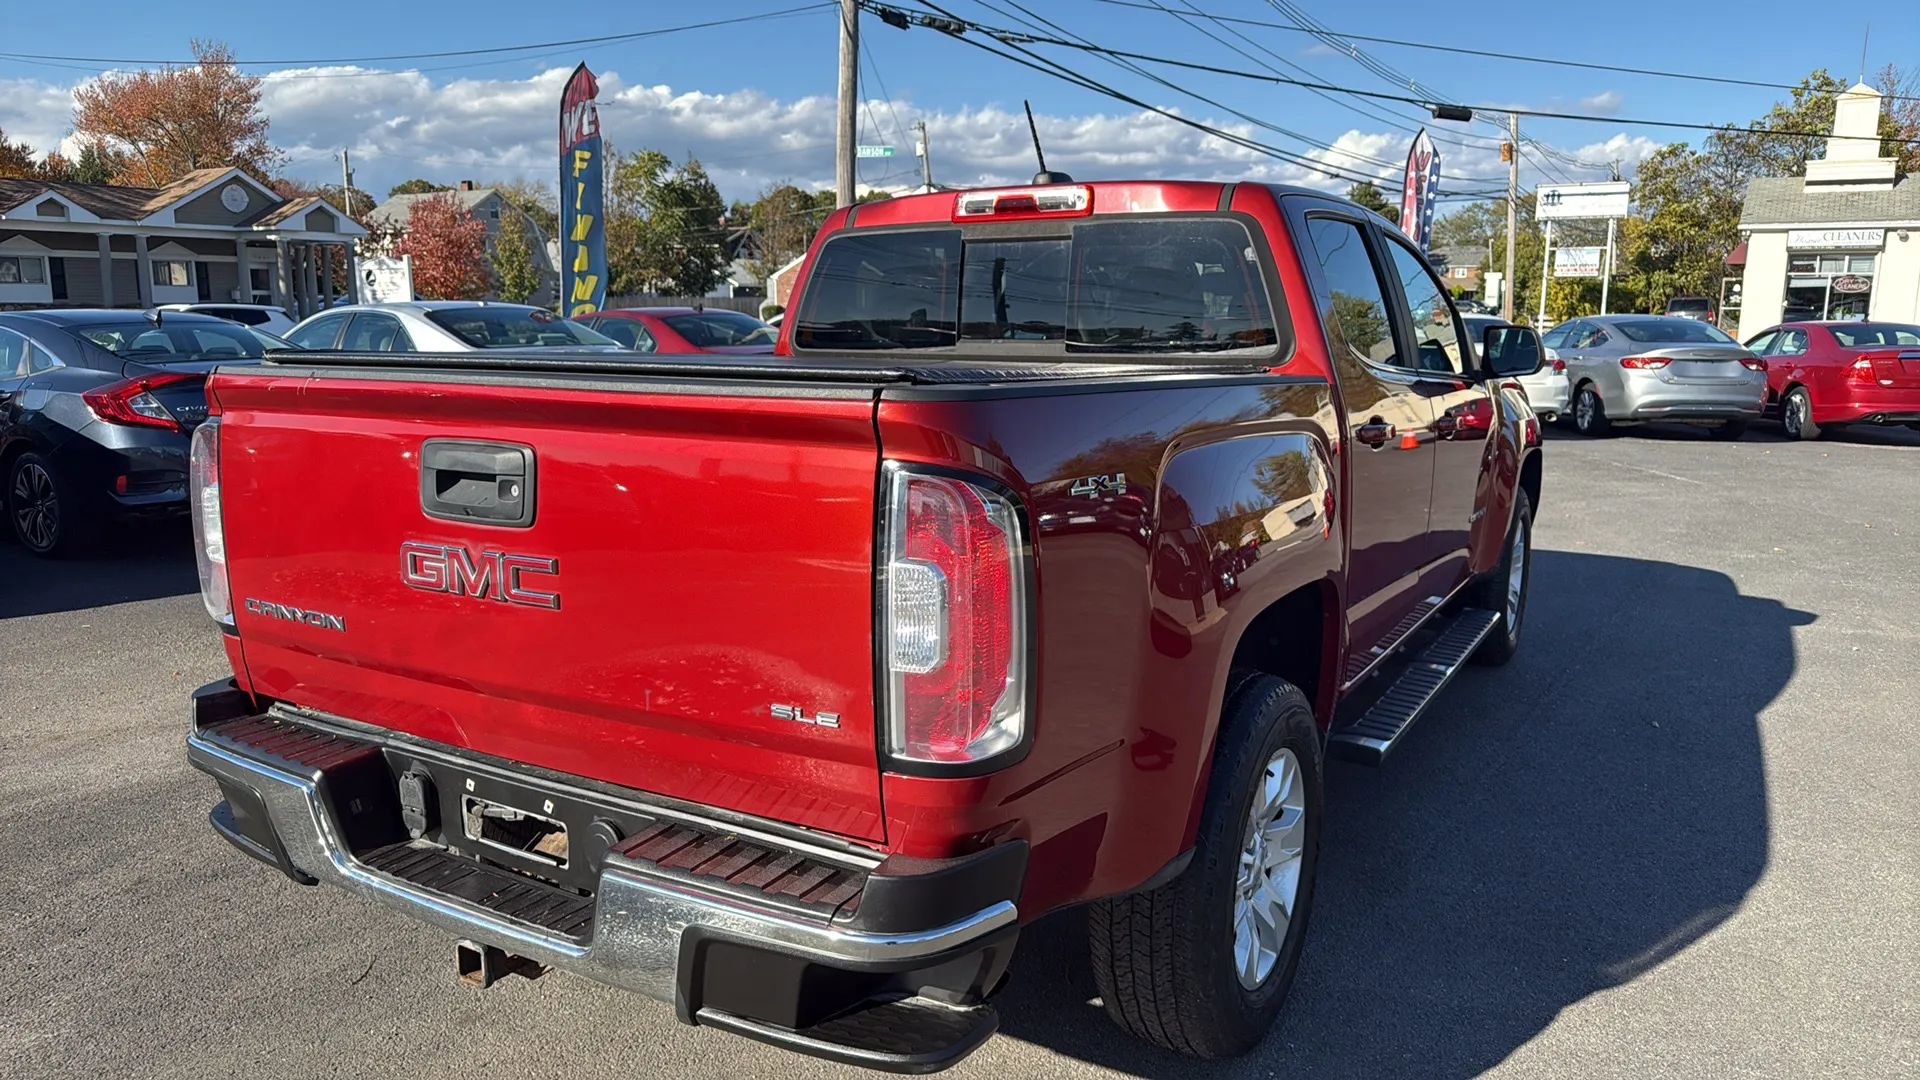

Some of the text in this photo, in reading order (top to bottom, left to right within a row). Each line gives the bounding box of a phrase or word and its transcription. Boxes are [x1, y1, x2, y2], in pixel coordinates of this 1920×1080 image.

[562, 99, 598, 148] WE
[1823, 231, 1882, 242] CLEANERS
[400, 540, 561, 611] GMC
[245, 597, 347, 632] CANYON
[770, 703, 841, 729] SLE
